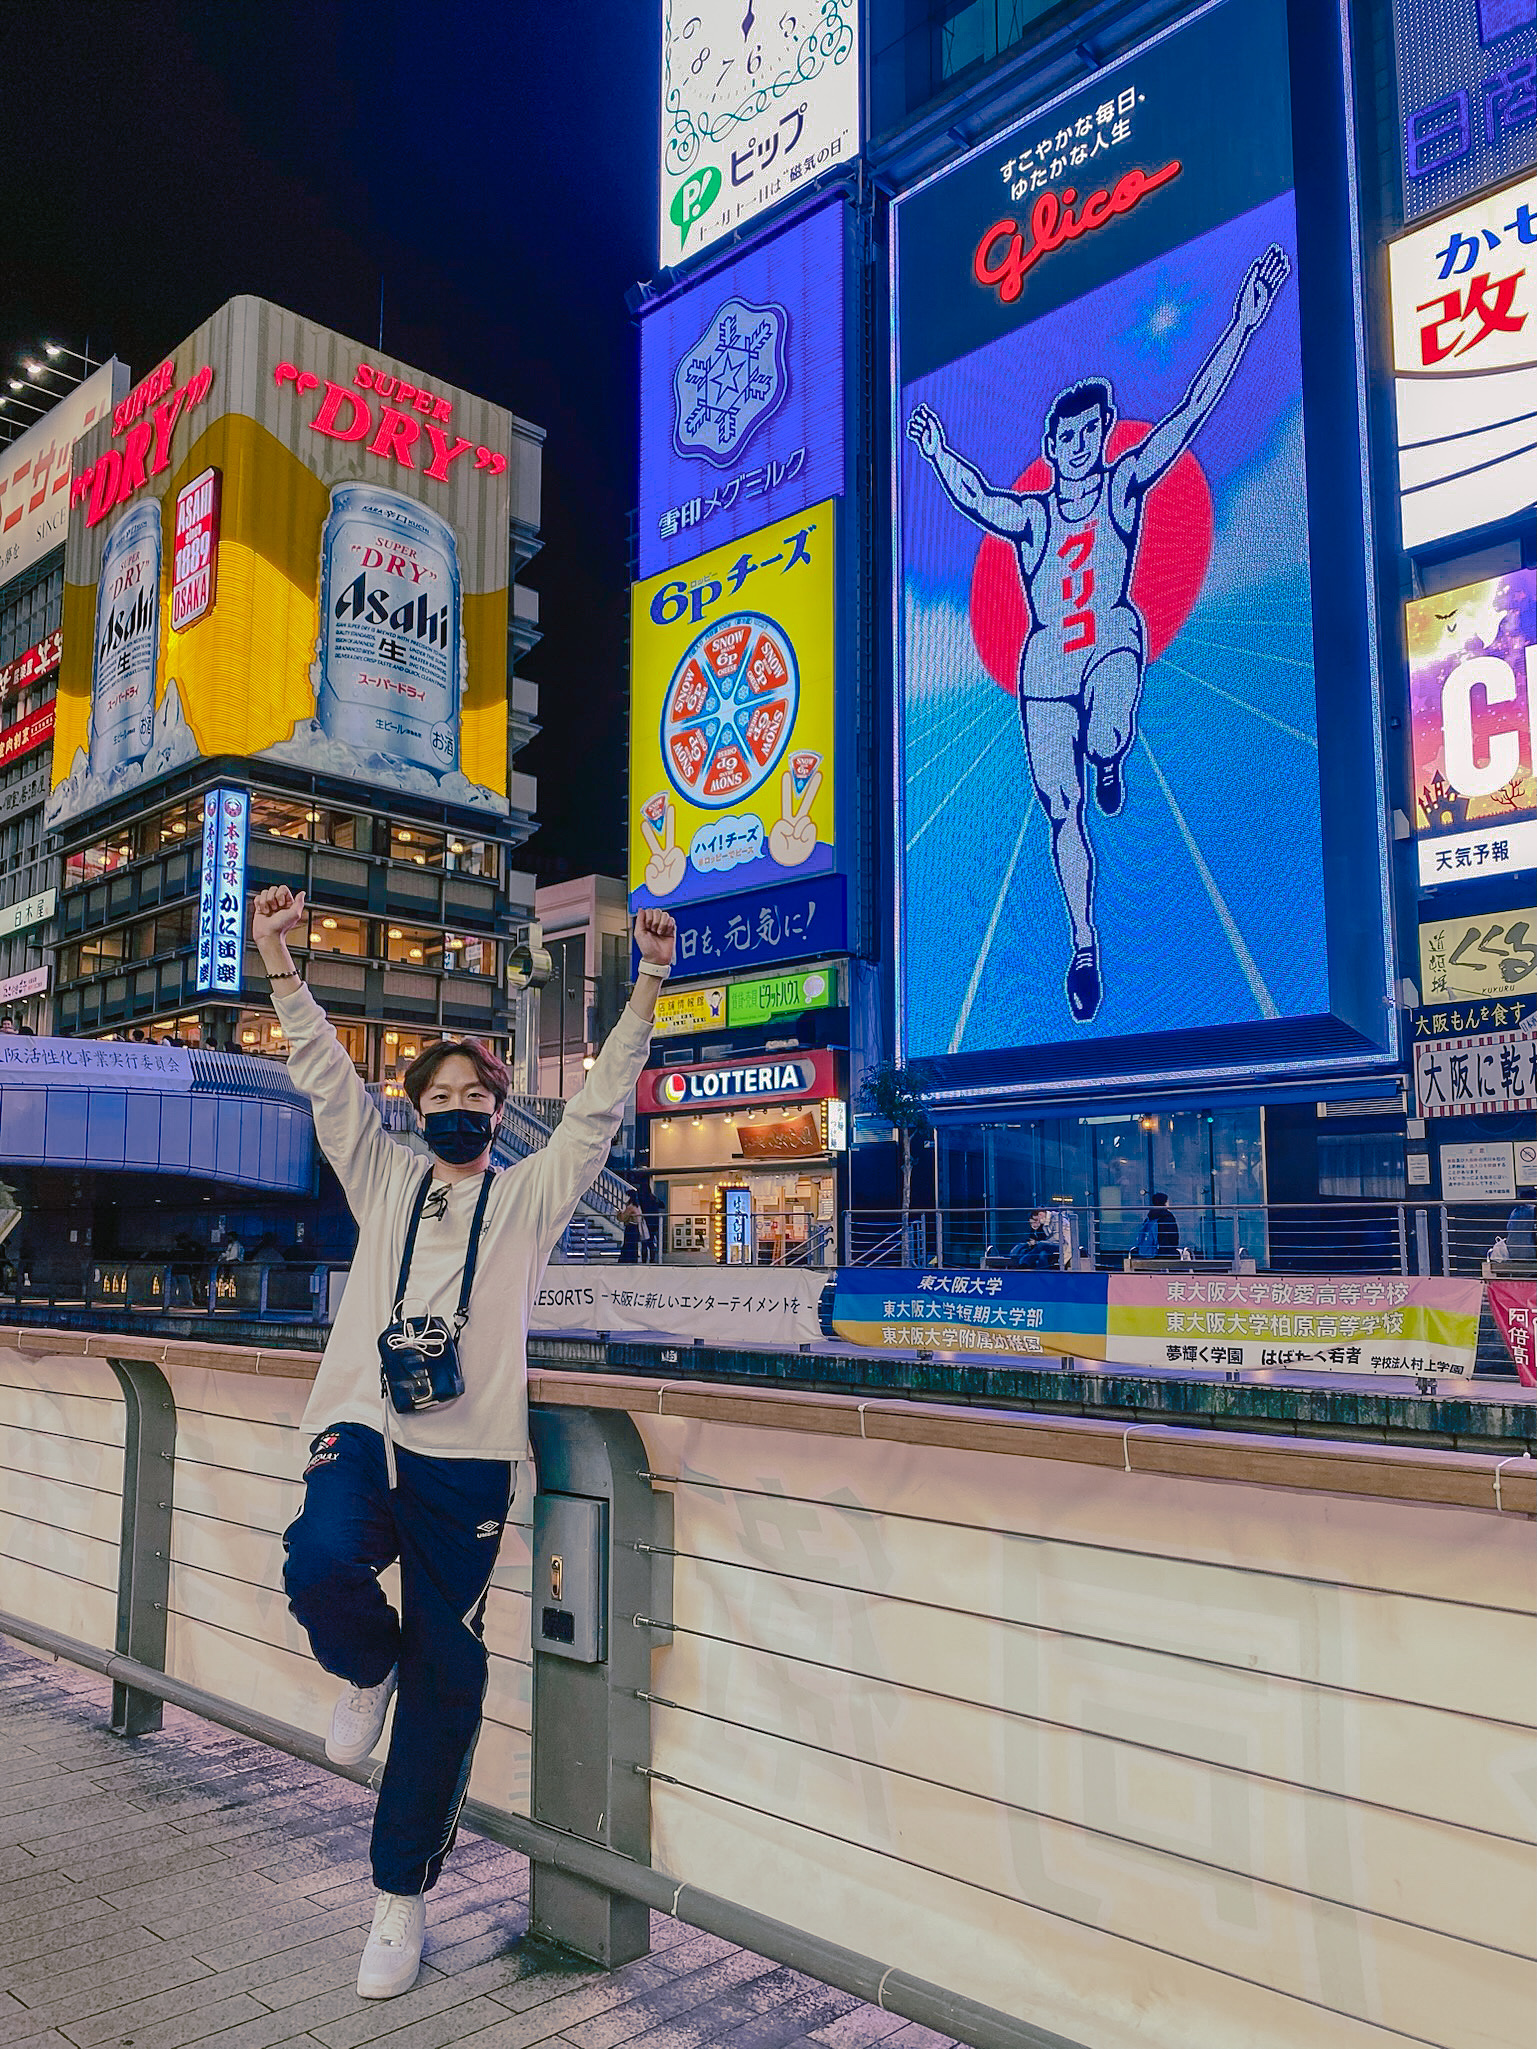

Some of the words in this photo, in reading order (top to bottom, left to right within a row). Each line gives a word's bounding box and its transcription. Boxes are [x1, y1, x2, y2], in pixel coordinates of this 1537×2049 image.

[730, 102, 808, 188] ピップ
[999, 85, 1147, 184] すこやかな毎日、
[1011, 117, 1133, 201] ゆたかな人生
[1416, 267, 1530, 367] 改
[112, 360, 175, 439] SUPER
[353, 361, 452, 424] SUPER
[177, 481, 214, 536] ASAHI
[657, 446, 807, 539] 雪印メグミルク
[36, 506, 66, 543] SINCE
[119, 551, 140, 573] SUPER
[174, 530, 211, 581] 1889
[376, 537, 417, 559] SUPER
[173, 571, 208, 623] OSAKA
[1058, 519, 1099, 654] グリコ
[99, 583, 155, 665] Asahi
[335, 571, 448, 650] Asahi
[378, 637, 407, 666] 生
[711, 629, 745, 653] SNOW
[117, 651, 131, 676] 生
[760, 641, 785, 679] SNOW
[358, 673, 426, 702] スーパードライ
[673, 668, 696, 714] SNOW
[432, 730, 454, 757] お酒
[760, 709, 785, 757] SNOW
[673, 741, 696, 778] SNOW
[709, 772, 744, 793] SNOW
[222, 821, 241, 887] 本場の味
[694, 824, 760, 853] ハイ!チーズ
[1435, 839, 1510, 872] 天気予報
[14, 898, 45, 928] 白木屋
[672, 901, 817, 966] 日を、元気に!
[1428, 929, 1448, 993] 道頓堀
[1481, 984, 1516, 994] KUKURU
[1414, 1001, 1526, 1037] 大阪もんを食す
[0, 1047, 180, 1073] 阪活性化事業実行委員会
[690, 1064, 799, 1098] LOTTERIA
[917, 1274, 1003, 1296] 東大阪大学
[1166, 1280, 1410, 1306] 東大阪大学敬愛高等学校
[882, 1299, 1044, 1328] 東大阪大学短期大学部
[1165, 1310, 1404, 1339] 東大阪大学柏原高等学校
[881, 1326, 1044, 1354] 東大阪大学附属幼稚園
[1165, 1343, 1244, 1366] 夢輝く学園
[1261, 1346, 1362, 1366] はばたく若者
[1371, 1355, 1465, 1375] 学校法人村上学園
